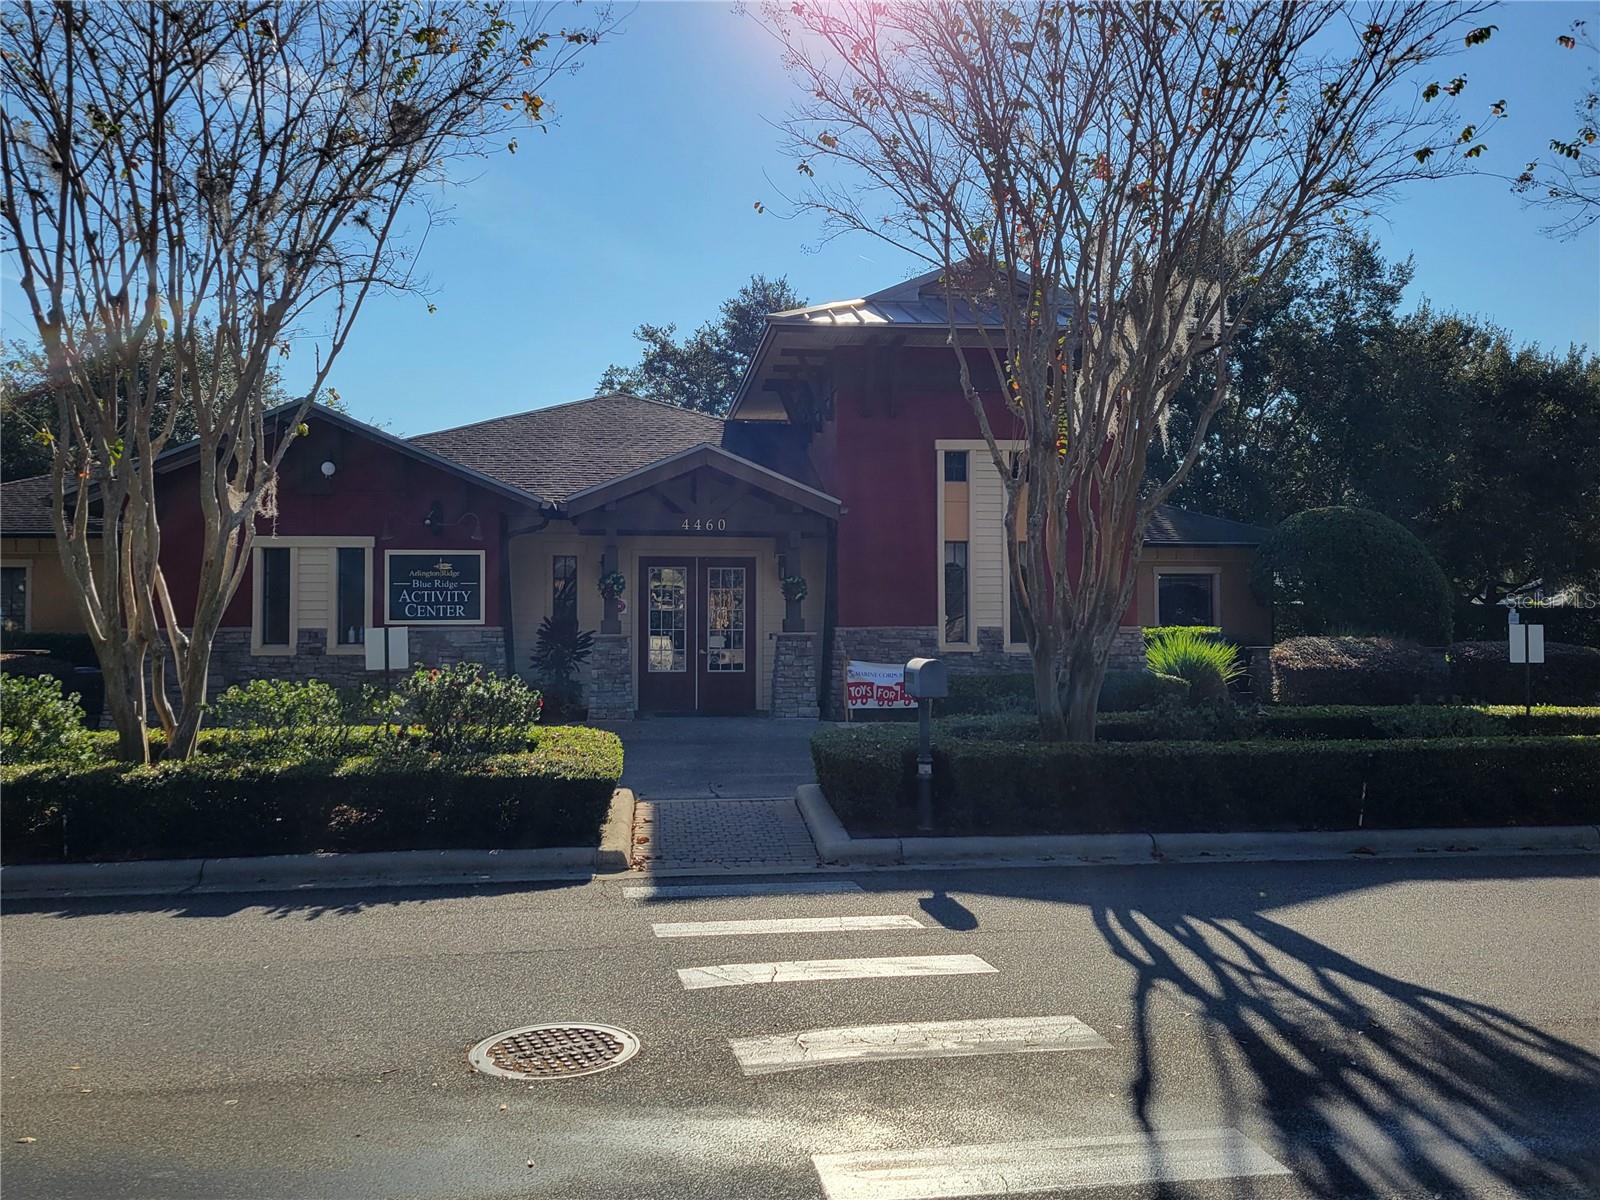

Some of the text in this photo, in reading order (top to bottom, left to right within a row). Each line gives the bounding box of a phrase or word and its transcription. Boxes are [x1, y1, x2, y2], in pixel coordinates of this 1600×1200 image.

[681, 518, 726, 531] 4460
[409, 570, 440, 578] Arlington
[412, 579, 458, 590] Blue Ridge
[399, 589, 472, 603] ACTIVITY
[404, 603, 466, 617] CENTER
[849, 684, 873, 698] TOYS
[877, 688, 896, 700] FOR
